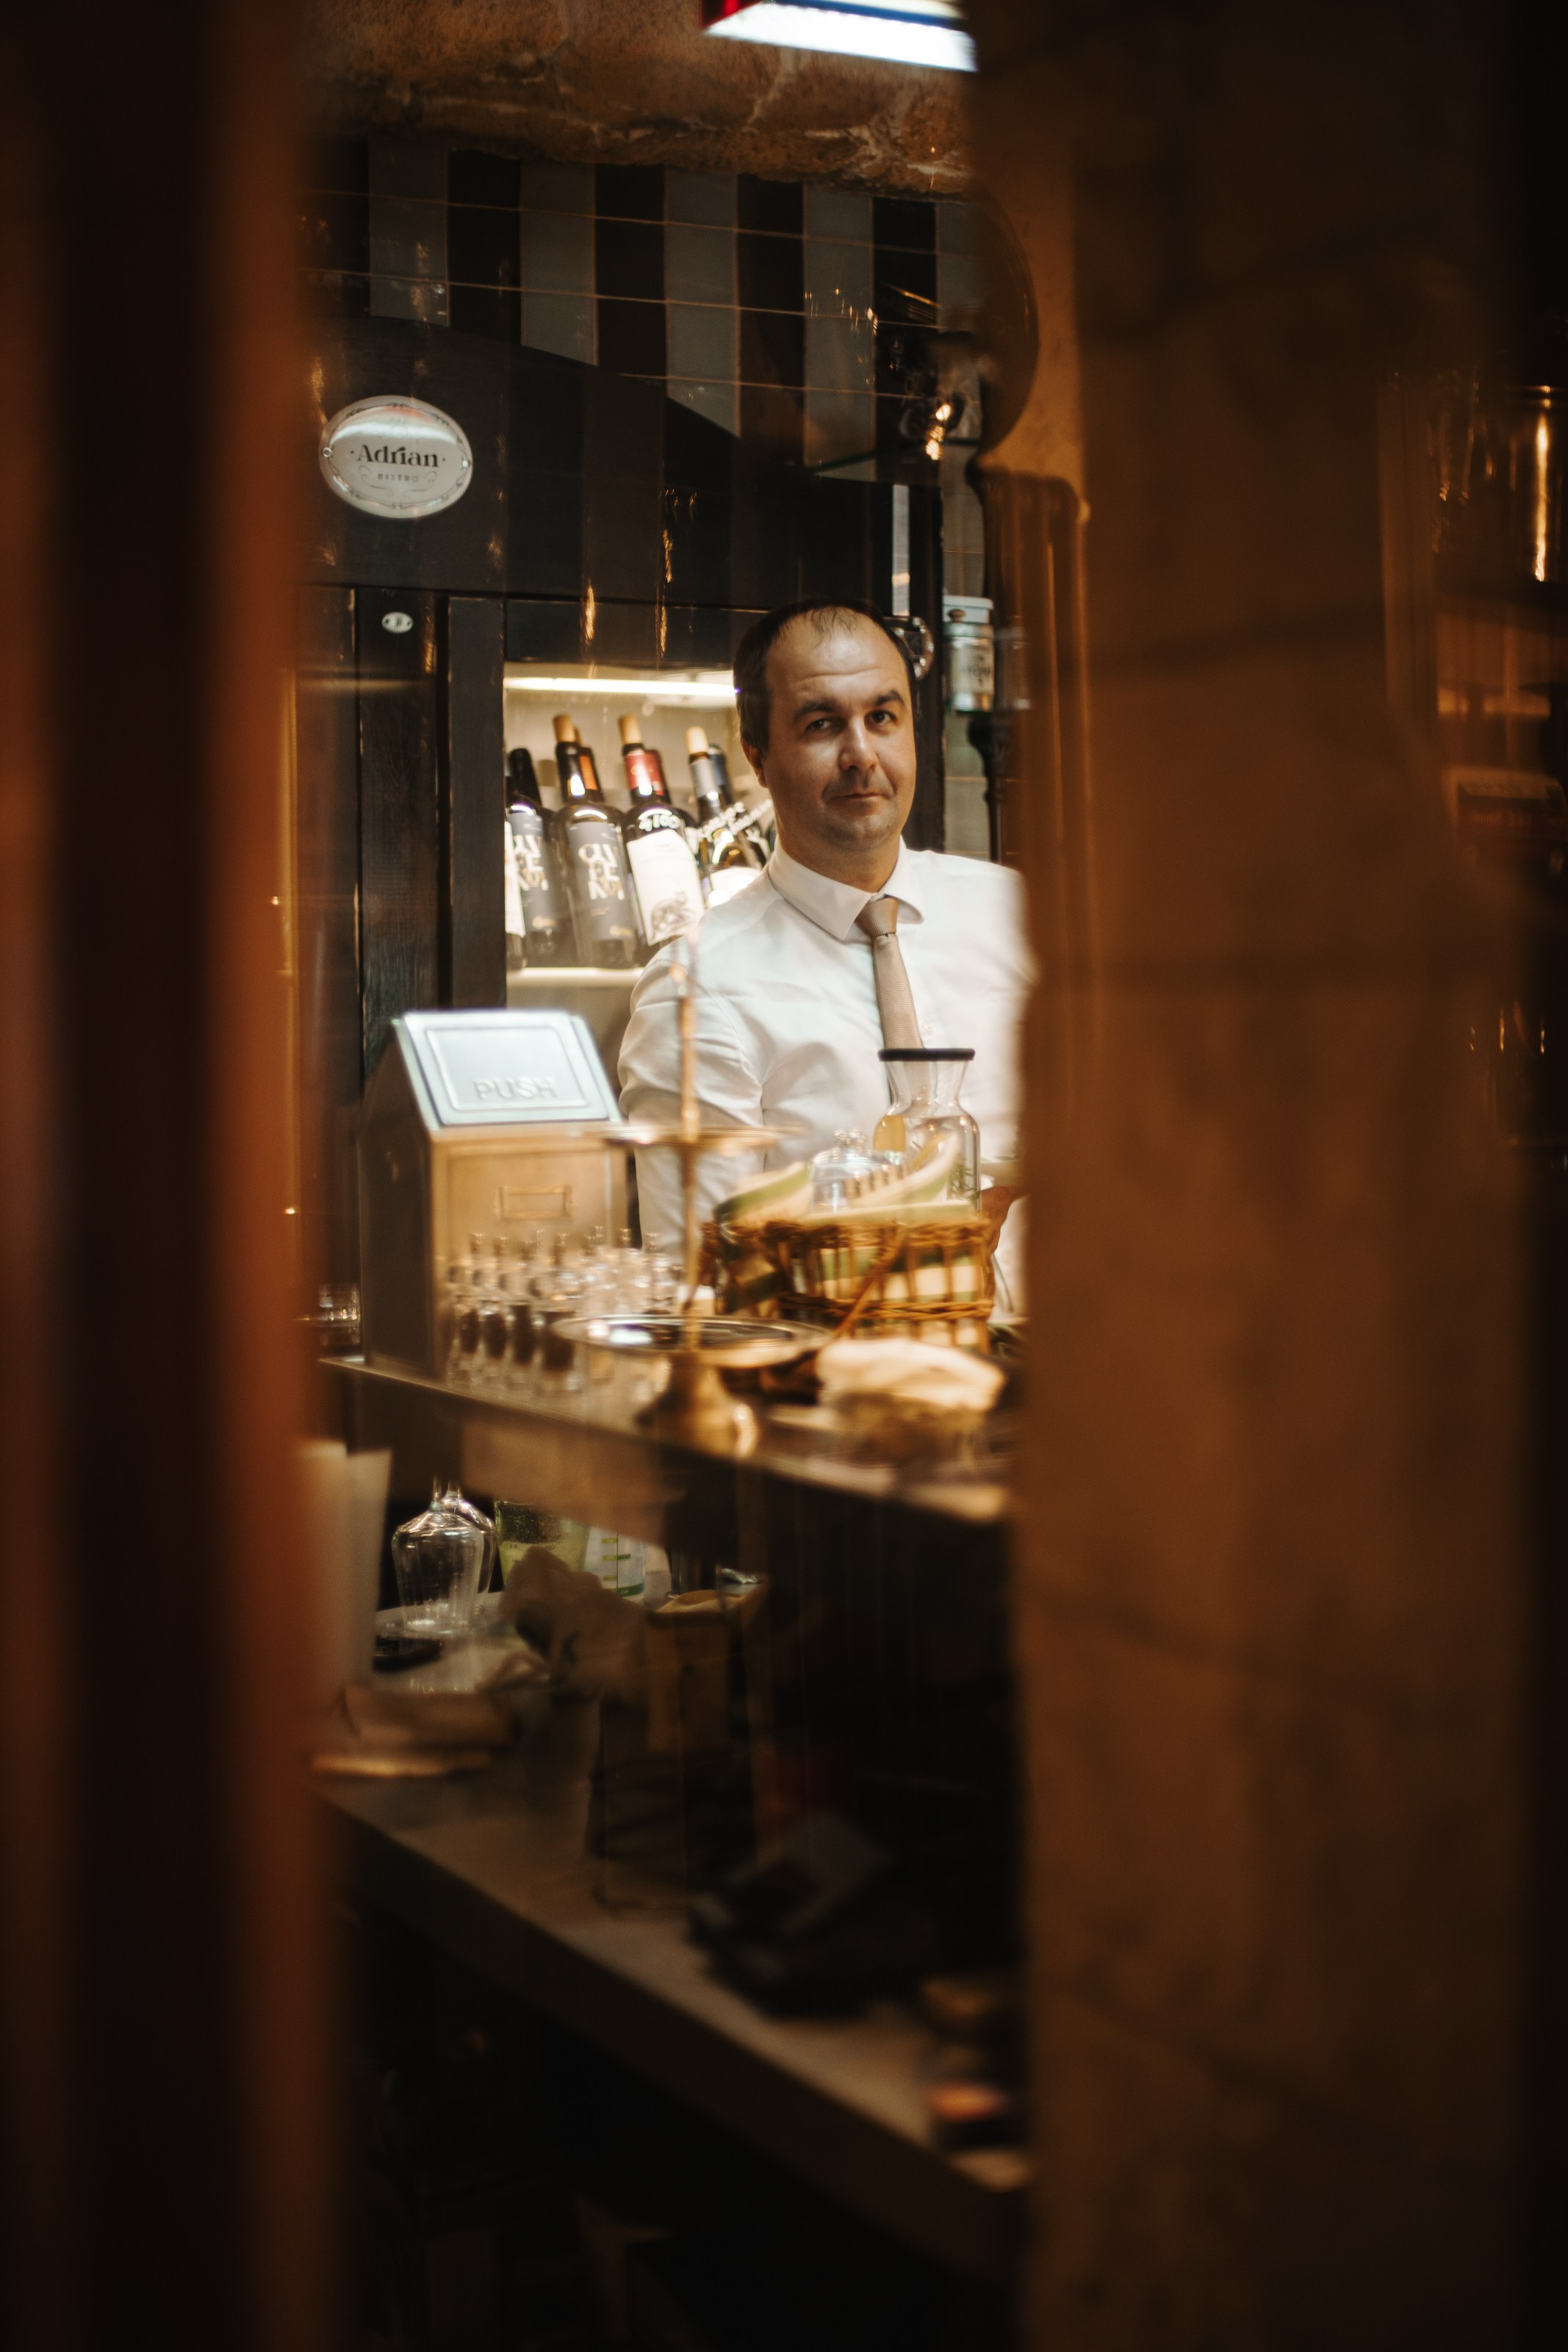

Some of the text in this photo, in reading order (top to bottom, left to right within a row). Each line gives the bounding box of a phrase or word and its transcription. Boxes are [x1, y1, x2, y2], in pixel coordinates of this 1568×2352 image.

[358, 445, 439, 467] Adrian
[378, 473, 419, 482] BISTRO
[473, 1078, 556, 1100] PUSH
